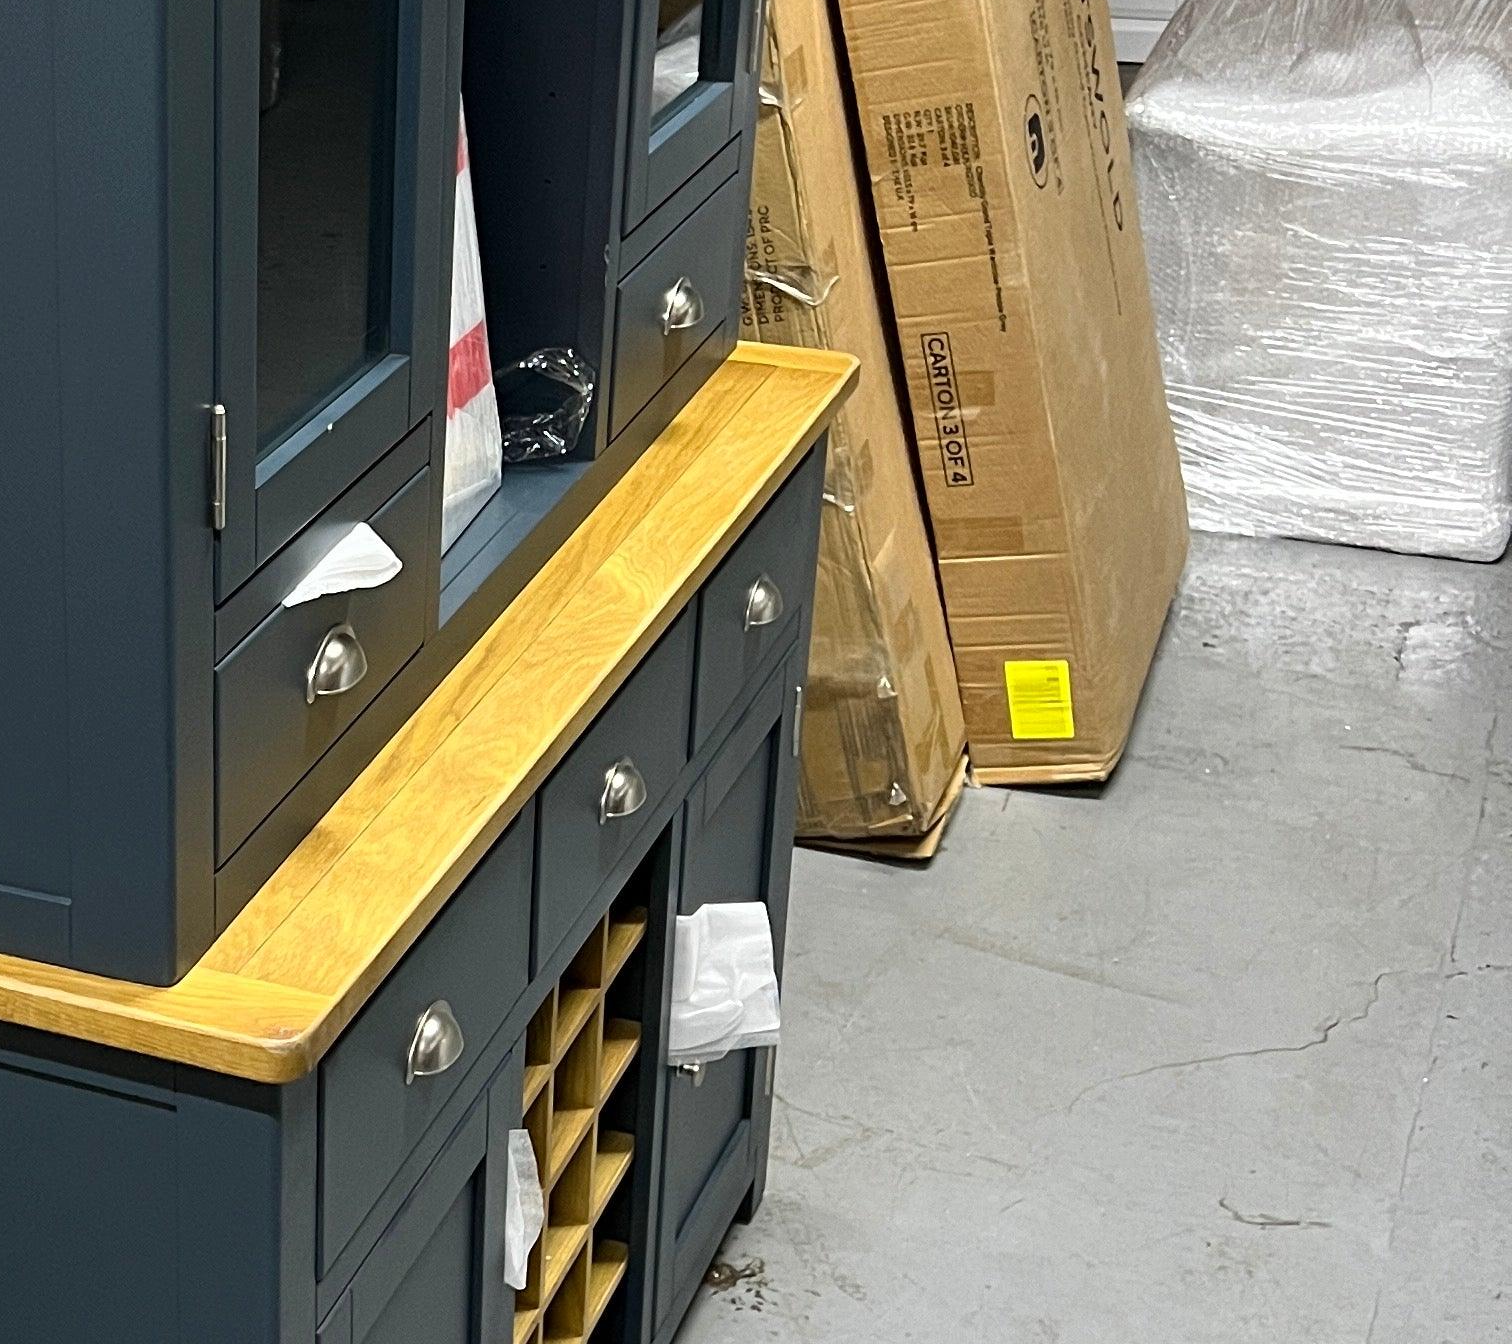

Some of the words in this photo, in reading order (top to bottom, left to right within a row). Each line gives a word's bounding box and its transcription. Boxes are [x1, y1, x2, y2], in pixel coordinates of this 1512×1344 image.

[757, 205, 772, 233] PRC
[762, 236, 775, 255] OF
[928, 337, 958, 421] CARTON
[943, 424, 959, 435] 3
[945, 440, 965, 469] OF
[951, 472, 968, 484] 4
